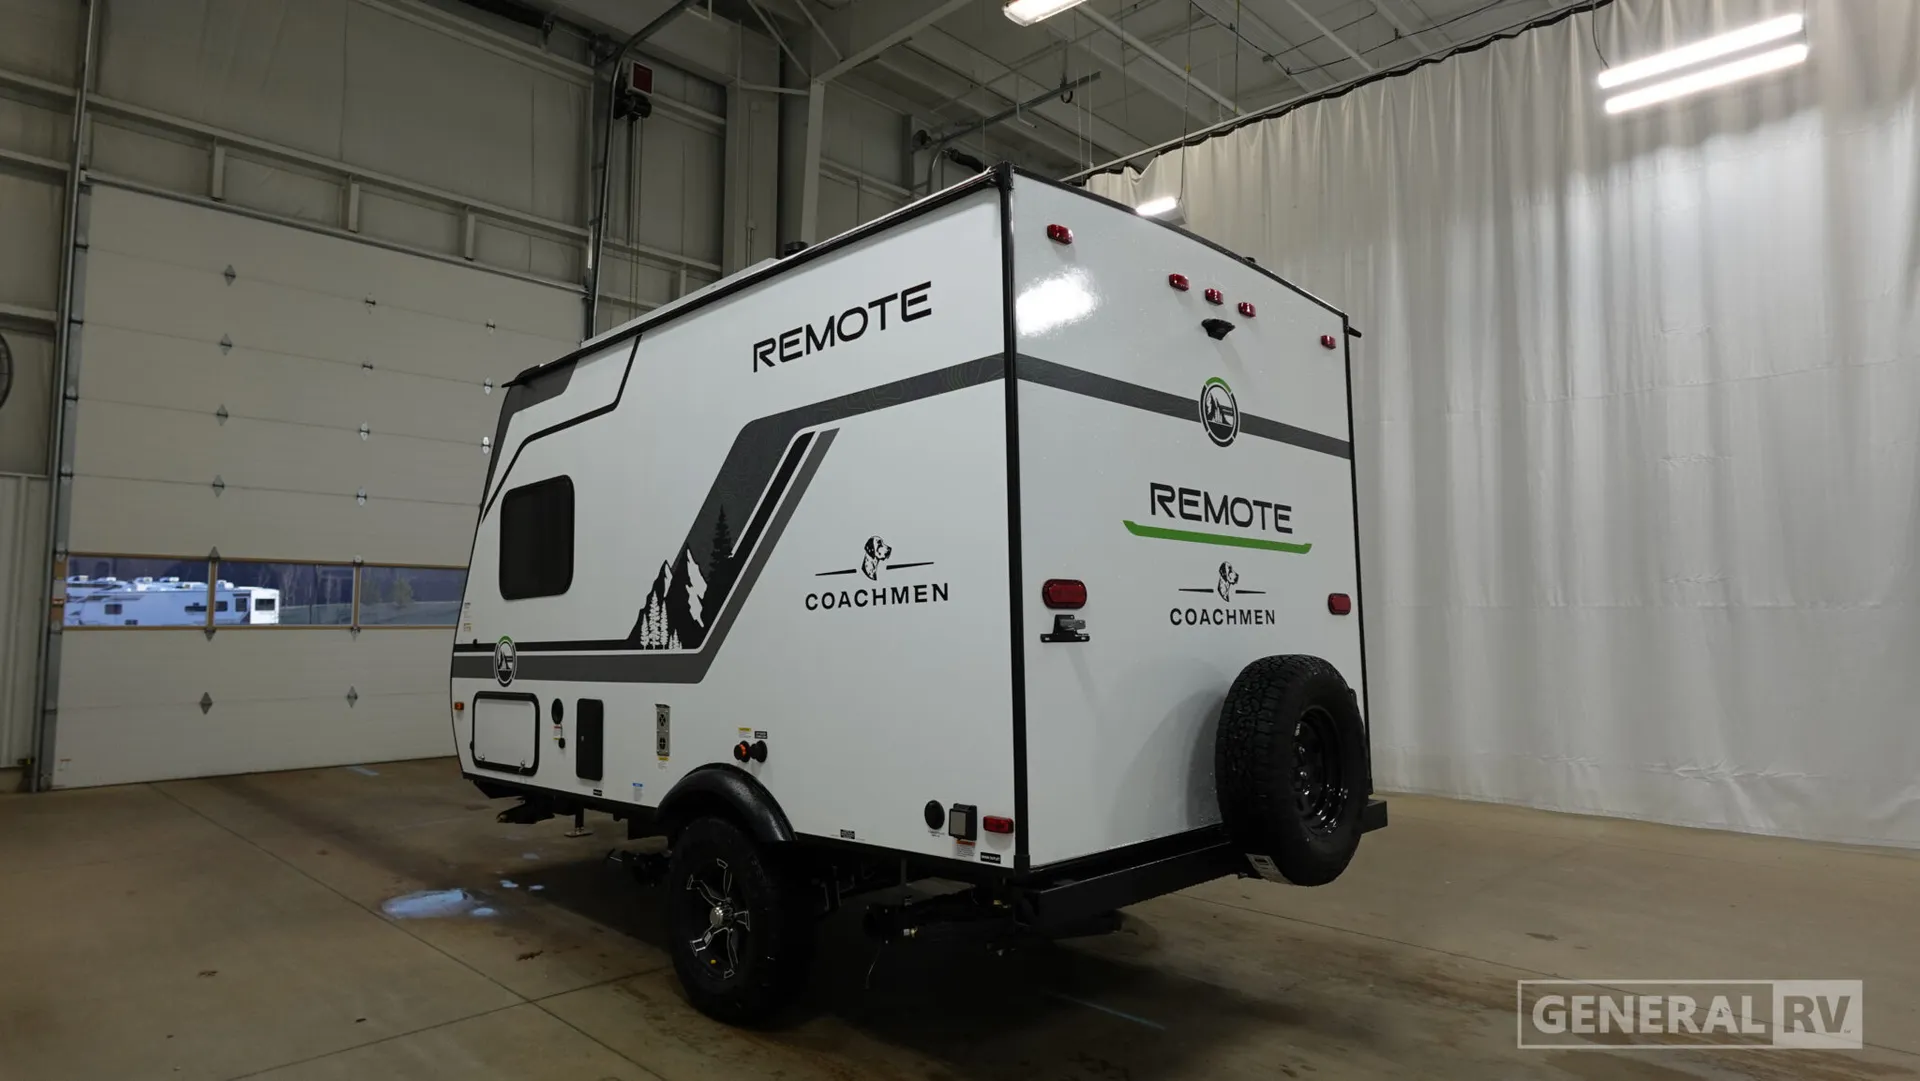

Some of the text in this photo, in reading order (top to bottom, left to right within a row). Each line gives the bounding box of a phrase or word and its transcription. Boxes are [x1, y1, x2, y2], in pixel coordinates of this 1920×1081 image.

[753, 281, 932, 373] REMOTE
[1150, 482, 1293, 534] REMOTE
[805, 583, 949, 611] COACHMEN
[1169, 608, 1276, 626] COACHMEN
